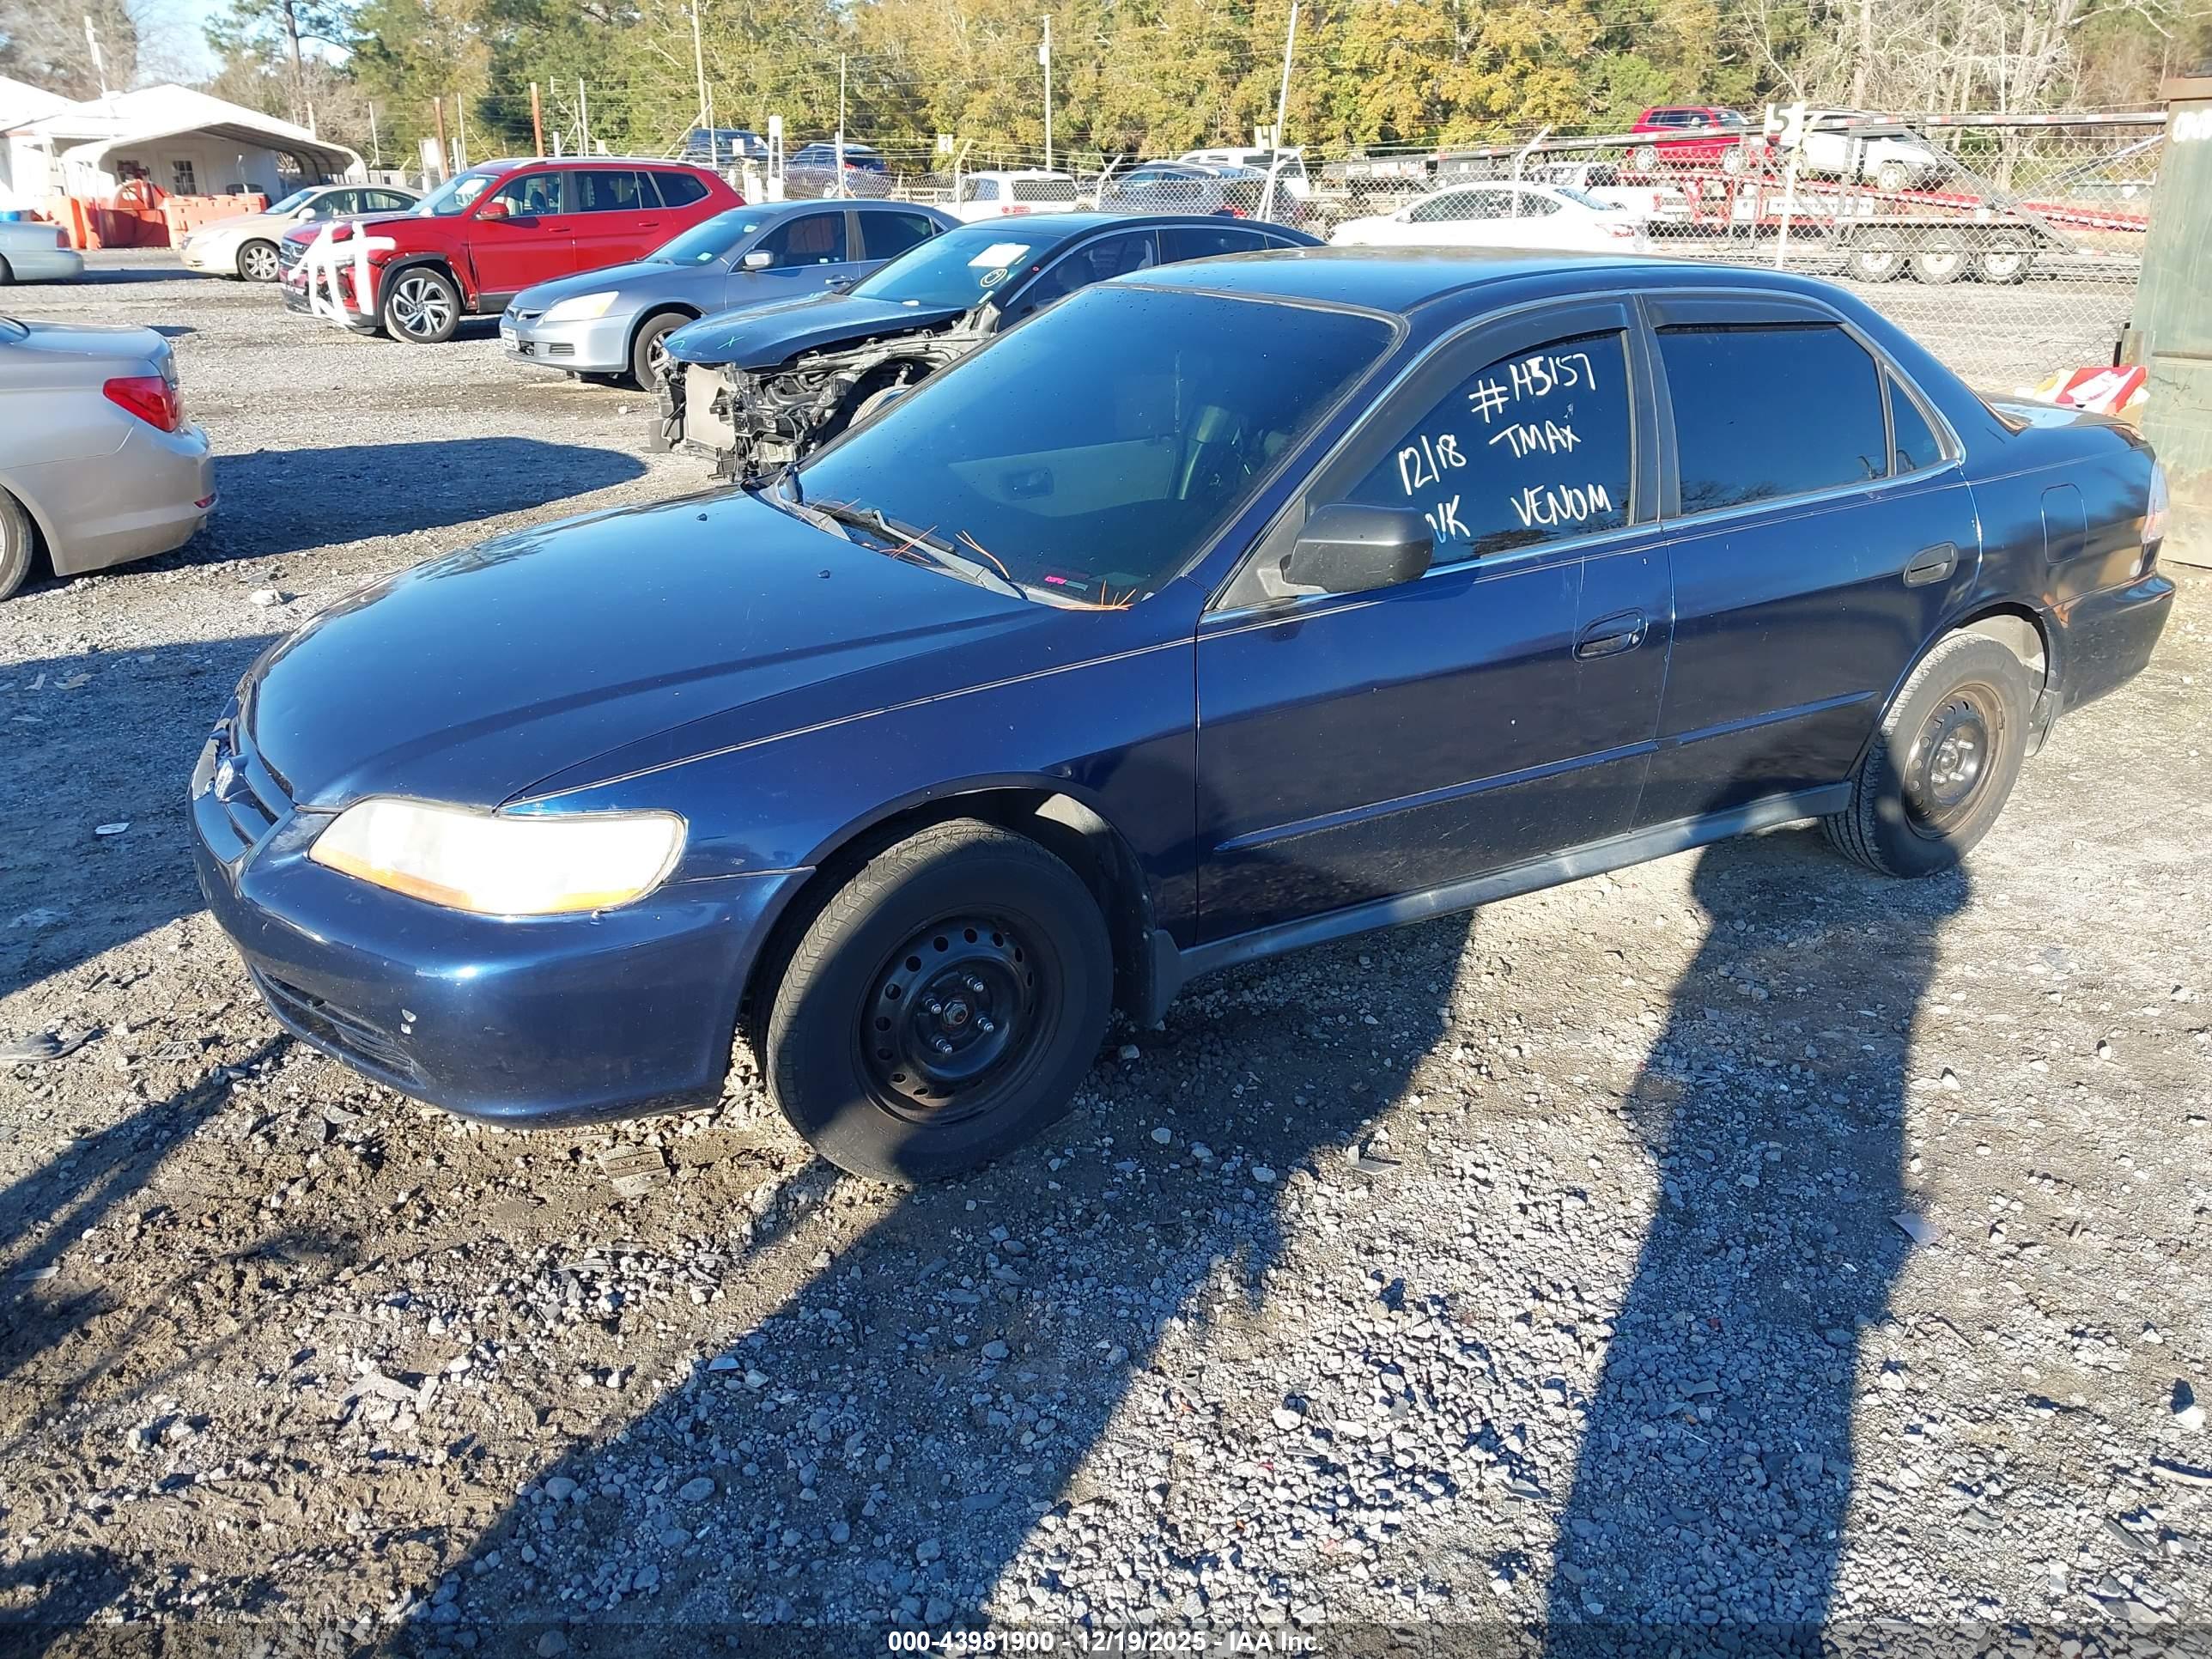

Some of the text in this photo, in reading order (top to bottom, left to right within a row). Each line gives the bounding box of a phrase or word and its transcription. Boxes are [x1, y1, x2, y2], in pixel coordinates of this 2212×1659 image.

[1767, 102, 1794, 135] 5
[1398, 434, 1467, 495] 12/18
[1510, 483, 1613, 527] VENOM
